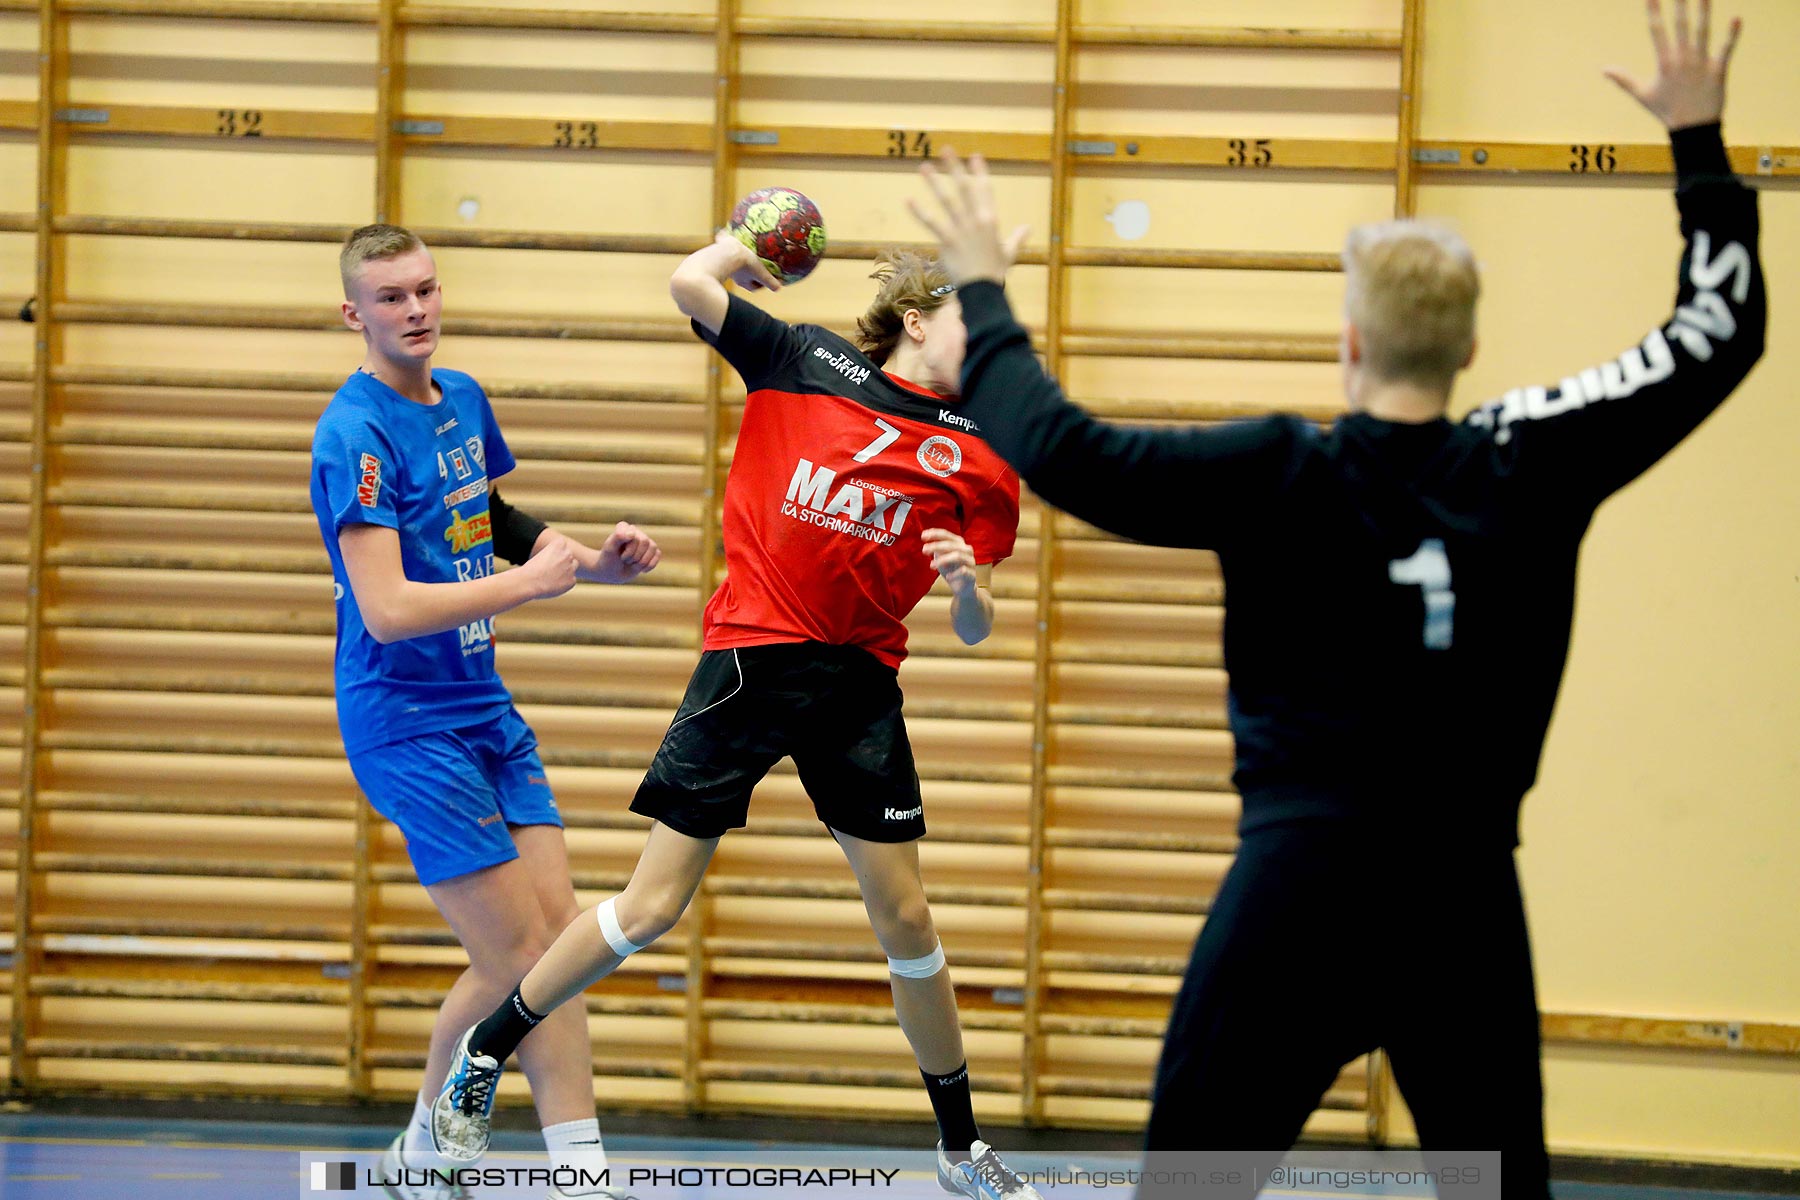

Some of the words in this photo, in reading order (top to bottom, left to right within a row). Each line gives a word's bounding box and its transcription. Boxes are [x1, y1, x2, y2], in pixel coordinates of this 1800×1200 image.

[216, 109, 263, 137] 32
[554, 121, 599, 149] 33
[887, 129, 931, 159] 34
[1227, 138, 1273, 168] 35
[1569, 143, 1616, 175] 36
[837, 352, 871, 383] TEAM
[852, 417, 902, 464] 7
[358, 455, 378, 506] MAXI
[436, 451, 448, 481] 4
[785, 457, 913, 536] MAXI
[780, 501, 798, 519] ICA
[799, 508, 897, 548] STORMARKNAD
[1387, 537, 1457, 651] 1
[884, 805, 922, 821] Kempa
